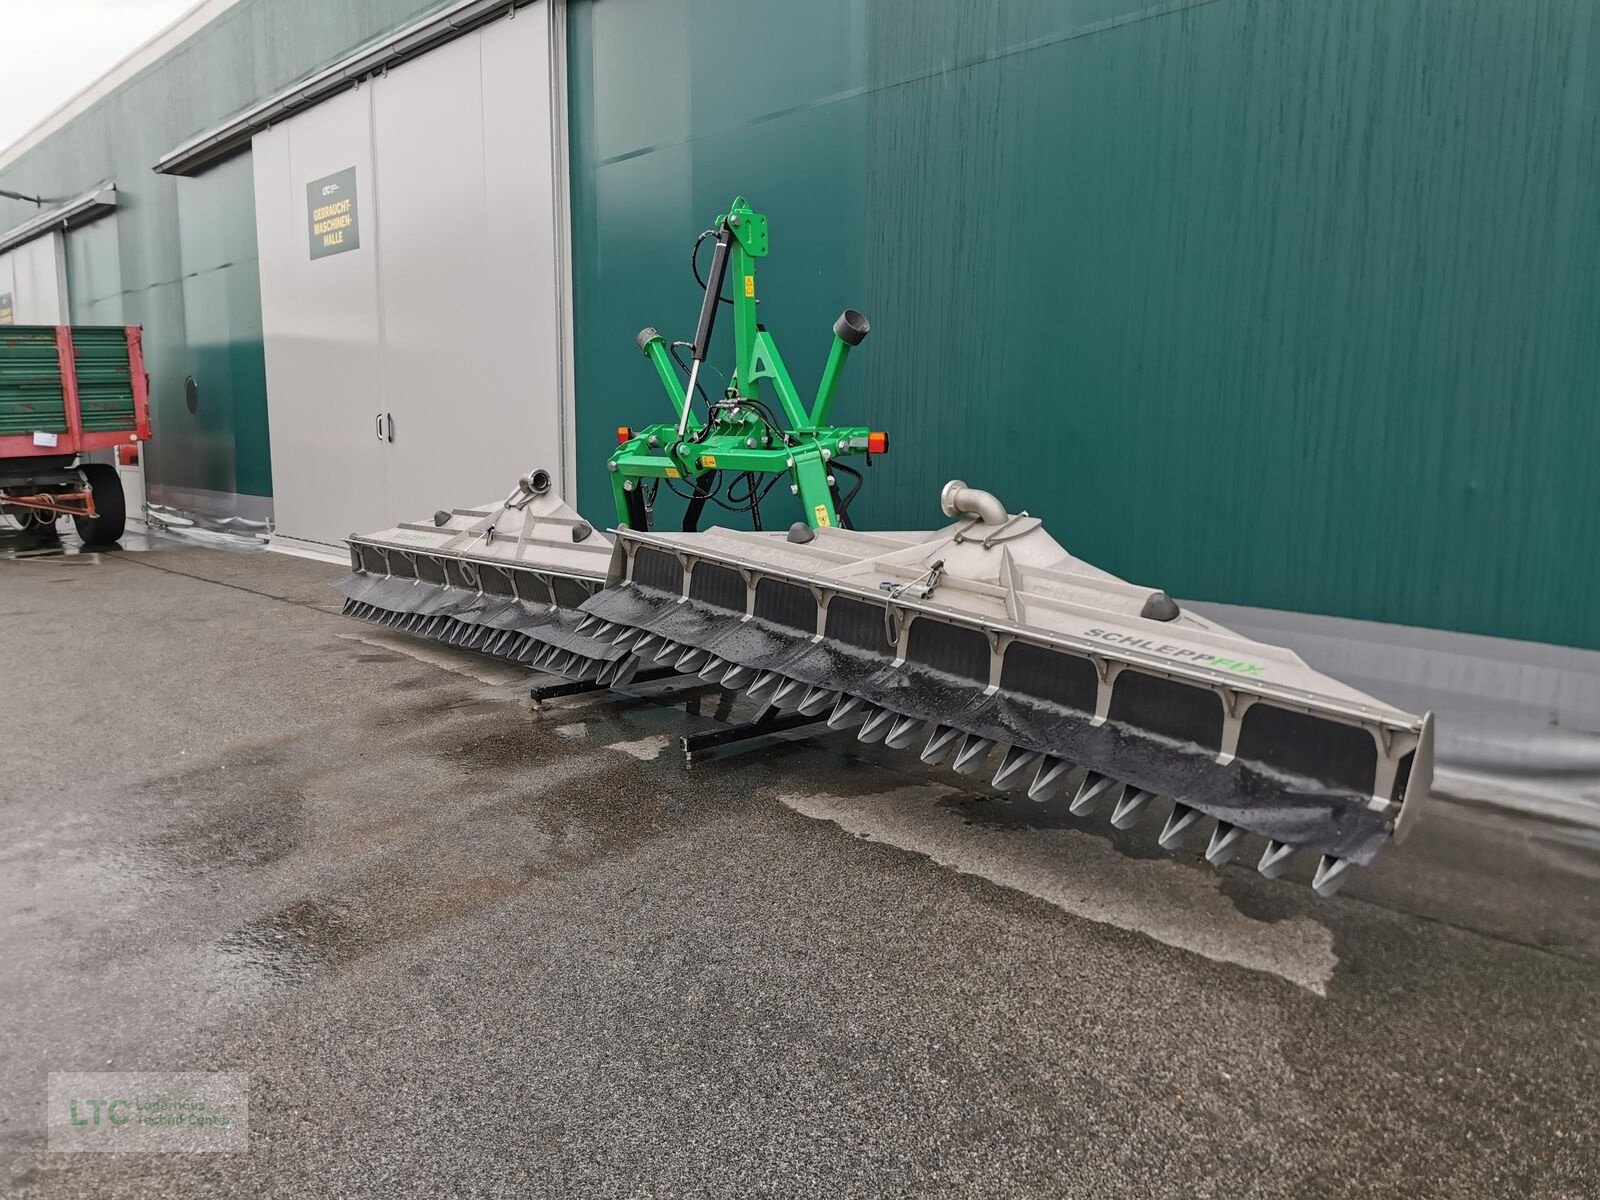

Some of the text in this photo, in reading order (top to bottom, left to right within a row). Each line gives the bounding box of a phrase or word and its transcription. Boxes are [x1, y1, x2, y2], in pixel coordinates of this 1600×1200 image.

[313, 199, 352, 221] GEBRAUCHT-
[313, 214, 353, 235] MASCHINEN-
[323, 231, 343, 247] HALLE
[1083, 628, 1265, 675] SCHLEPPFIX
